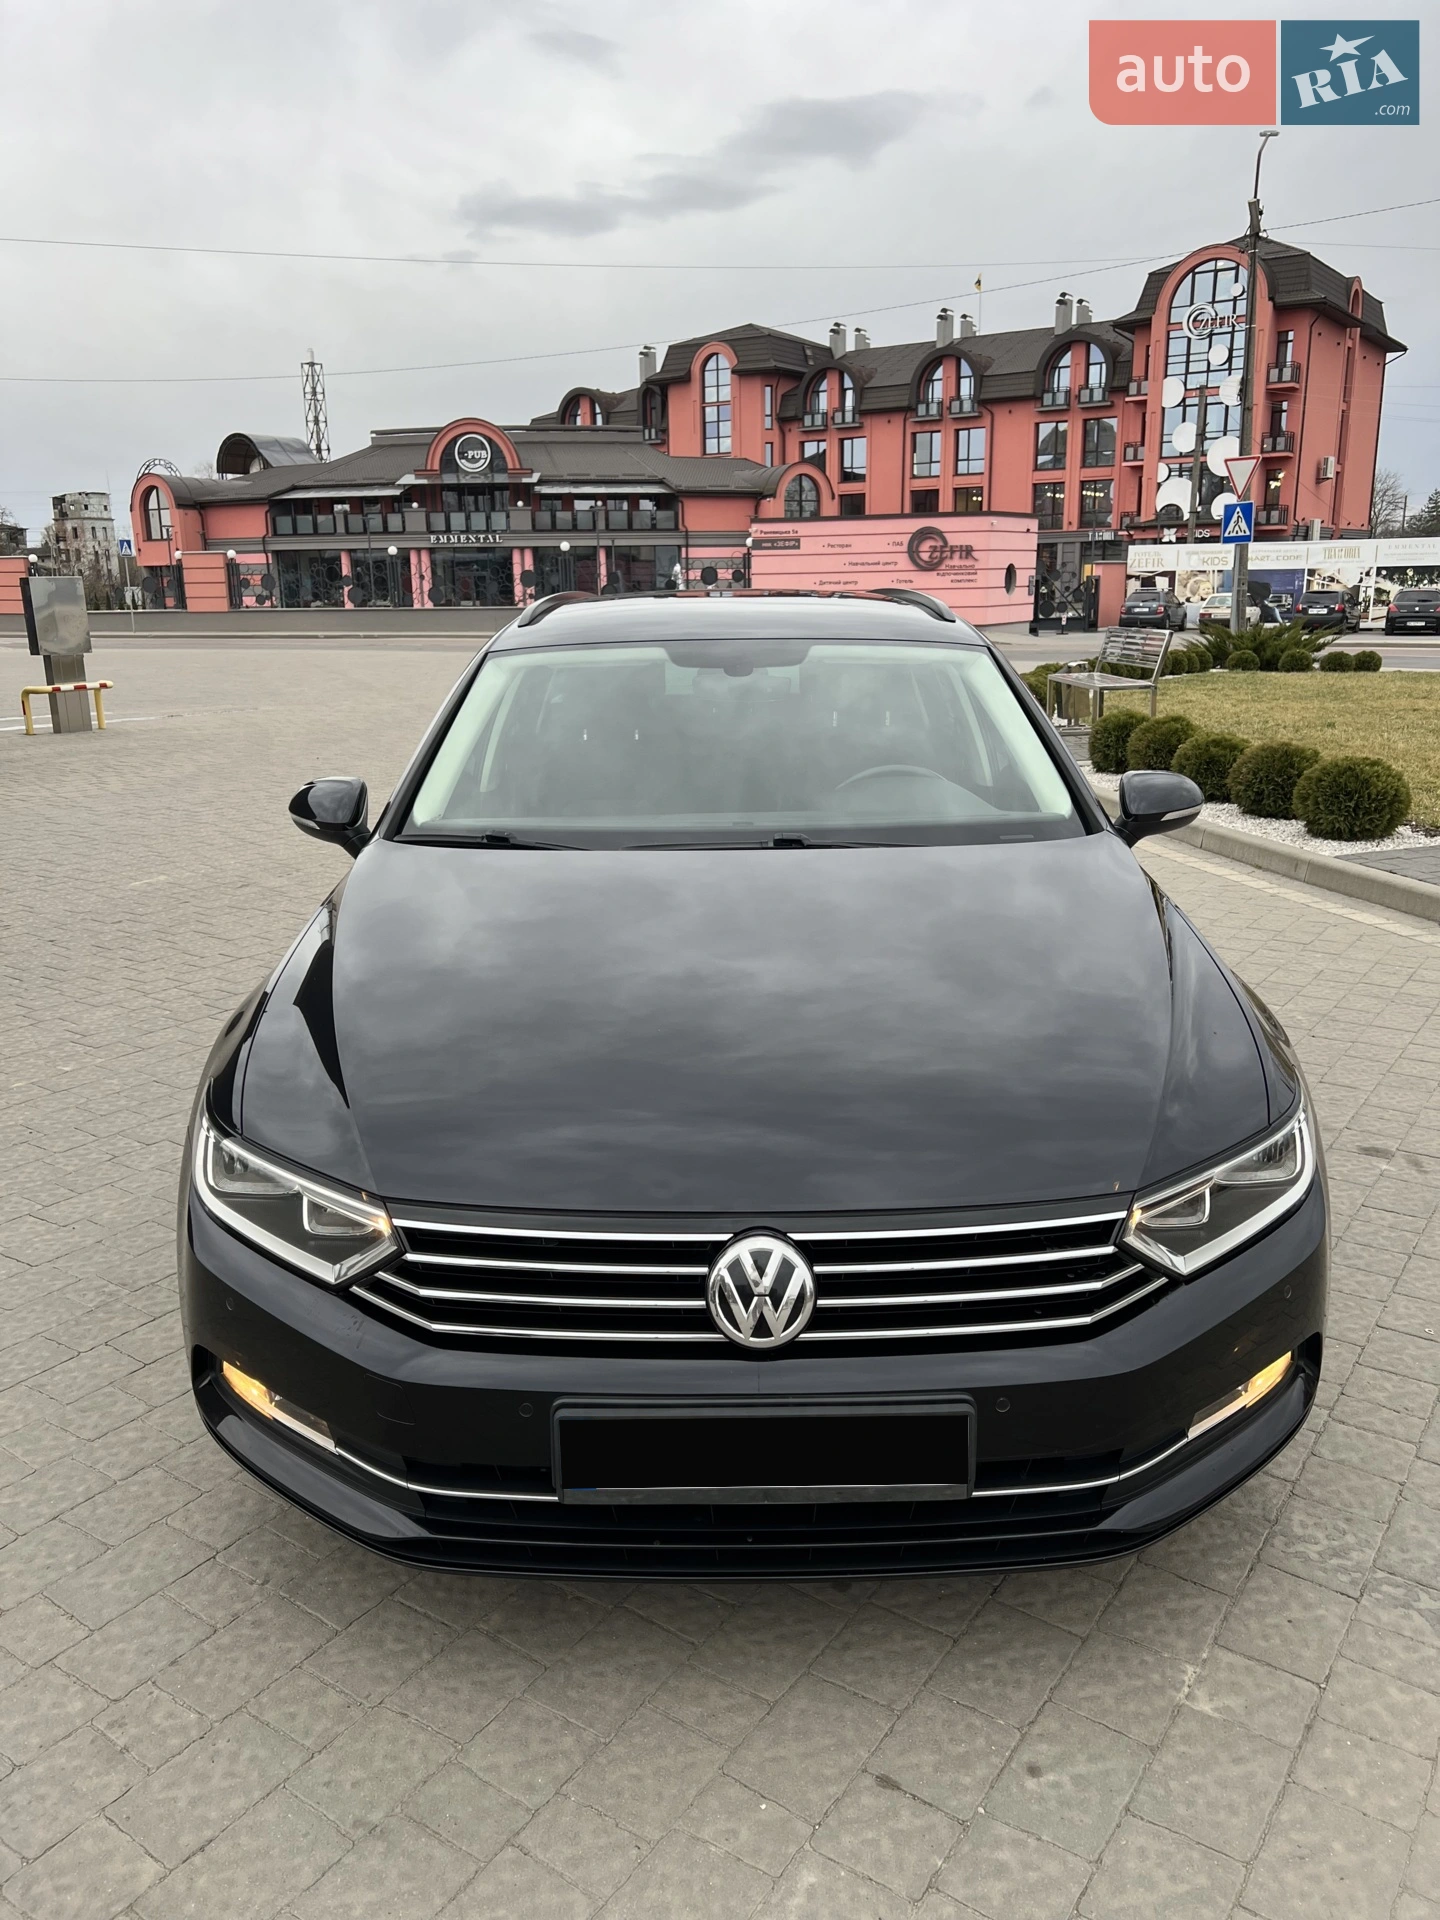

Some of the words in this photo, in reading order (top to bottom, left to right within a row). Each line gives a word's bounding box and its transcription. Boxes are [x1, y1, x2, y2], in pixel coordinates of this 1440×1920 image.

[430, 534, 504, 544] EMMENTAL
[1129, 557, 1165, 569] ZEFIR
[1202, 556, 1229, 567] KIDS
